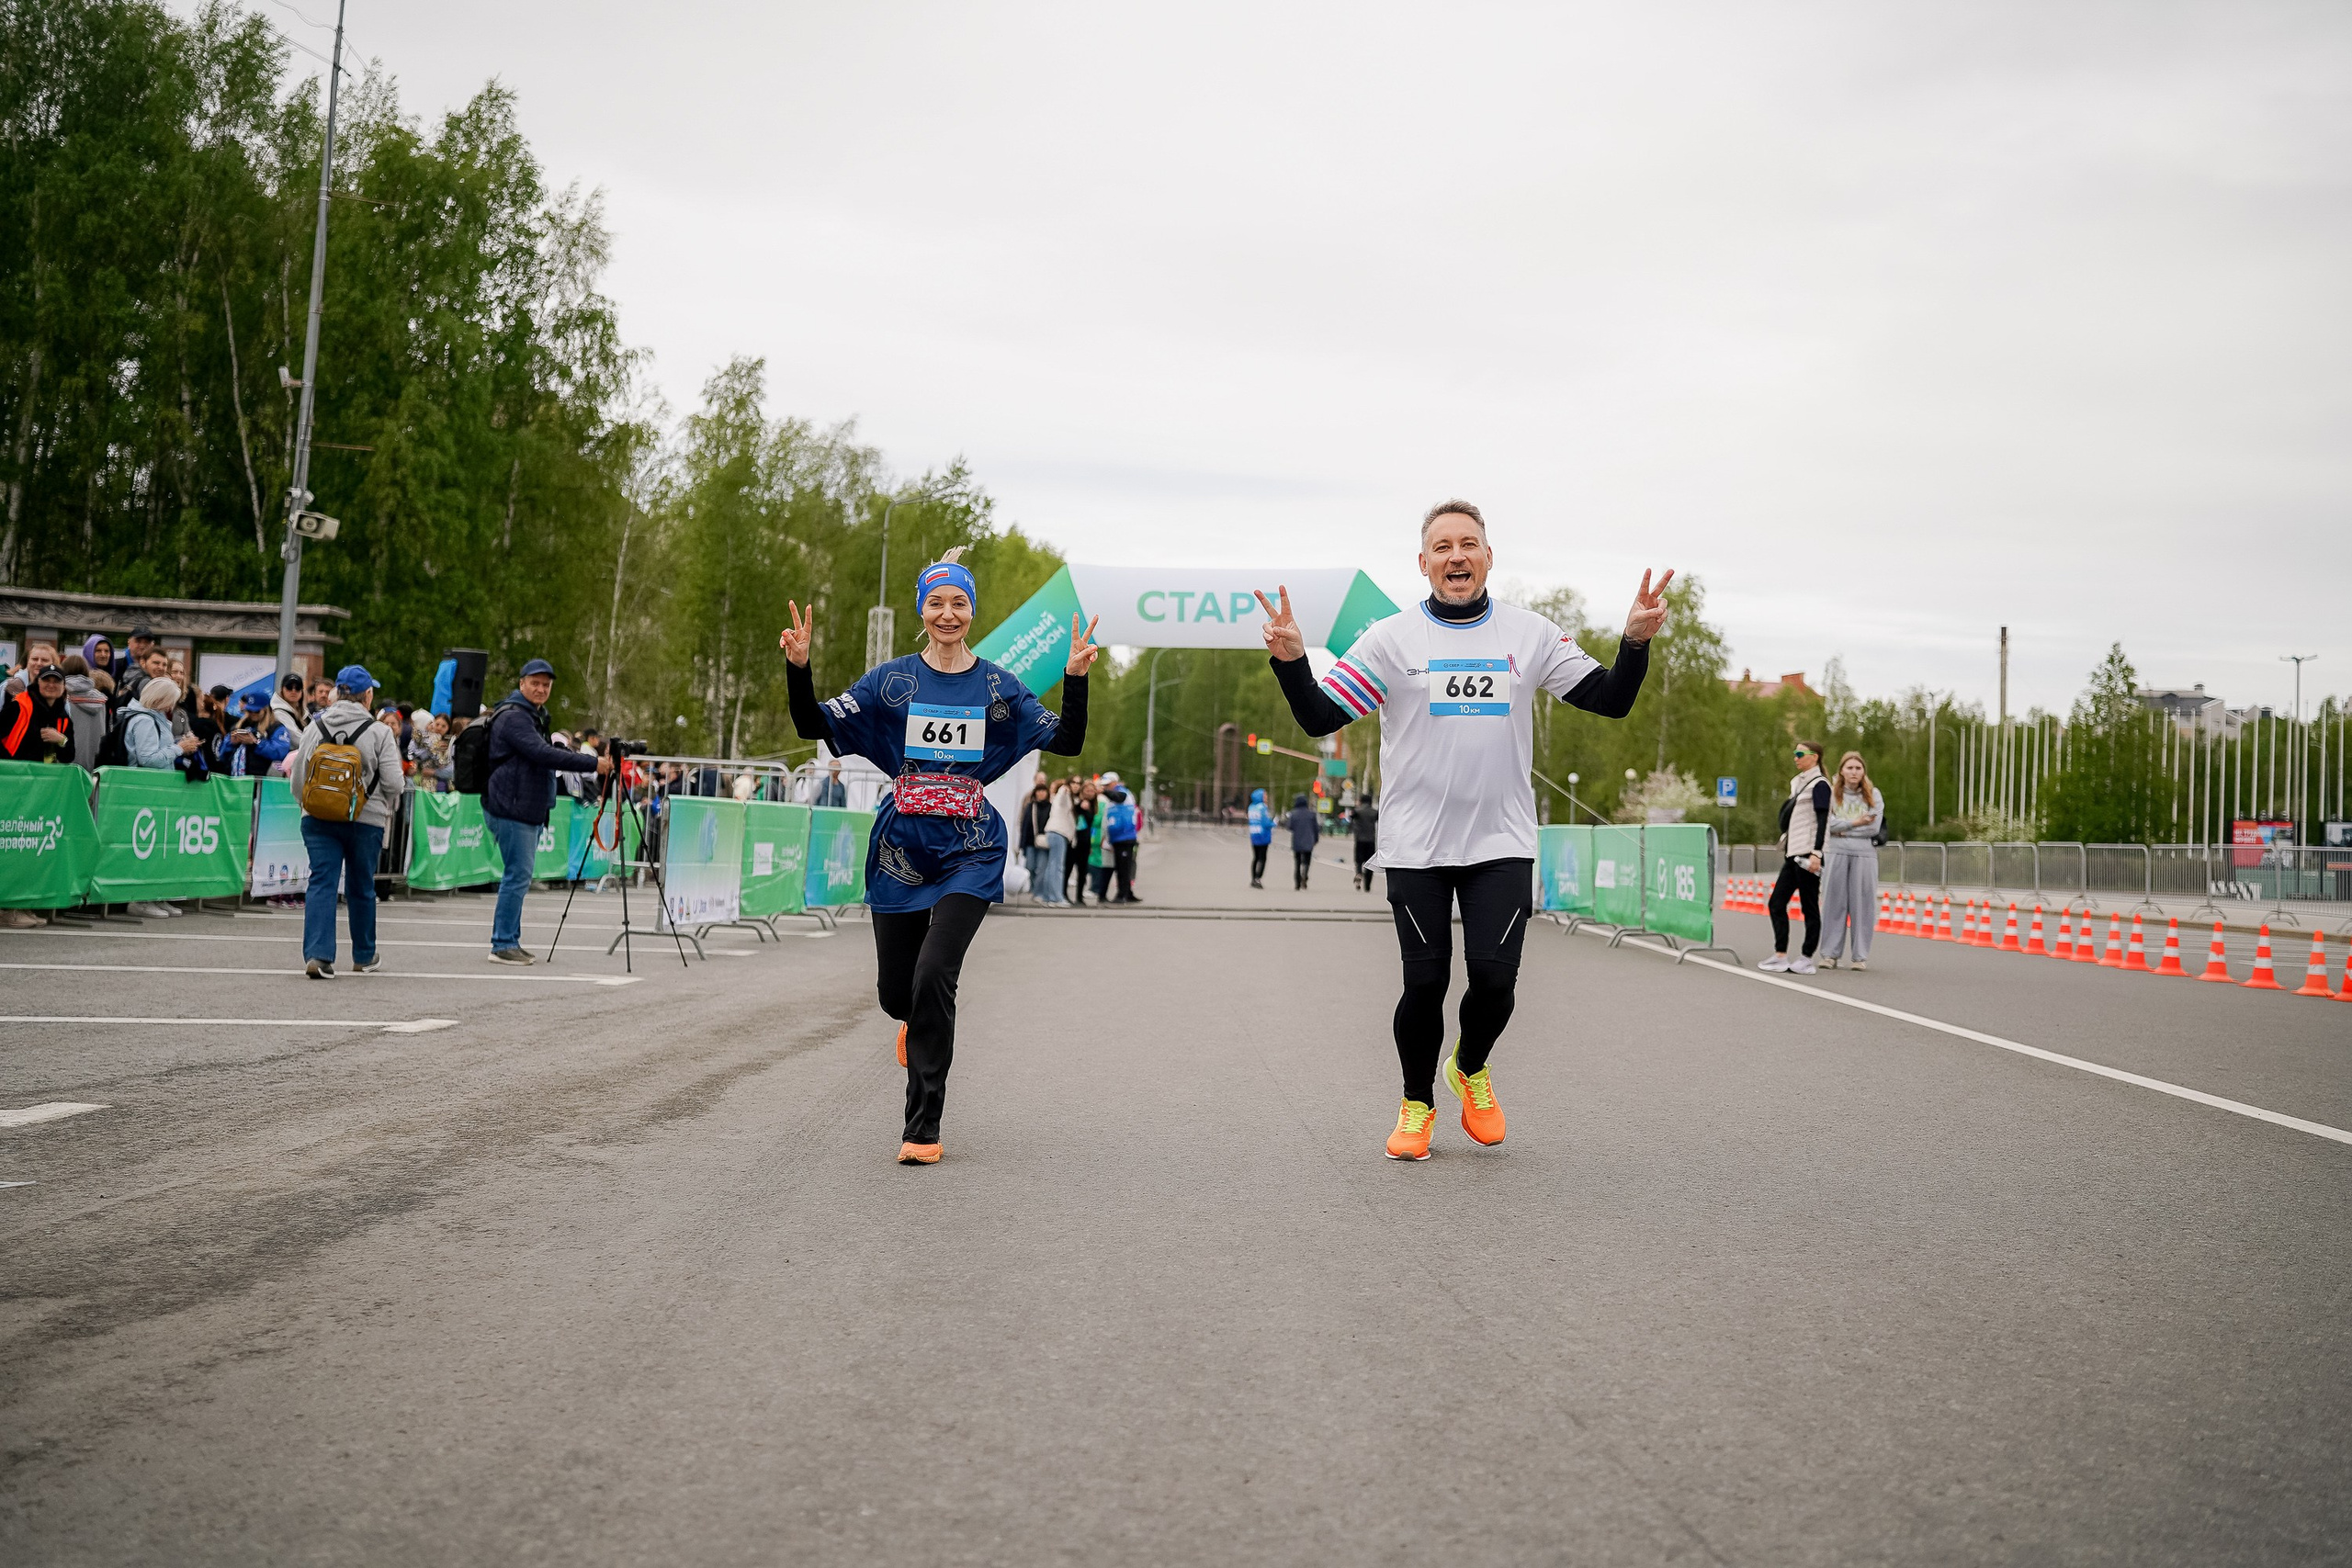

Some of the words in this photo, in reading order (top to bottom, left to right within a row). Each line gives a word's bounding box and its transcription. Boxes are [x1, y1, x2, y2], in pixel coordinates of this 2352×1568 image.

[1009, 625, 1067, 674] арафон
[1445, 676, 1494, 698] 662
[922, 721, 967, 745] 661
[0, 832, 40, 853] арафон
[175, 815, 220, 855] 185
[537, 825, 556, 853] 85
[1675, 865, 1695, 901] 185
